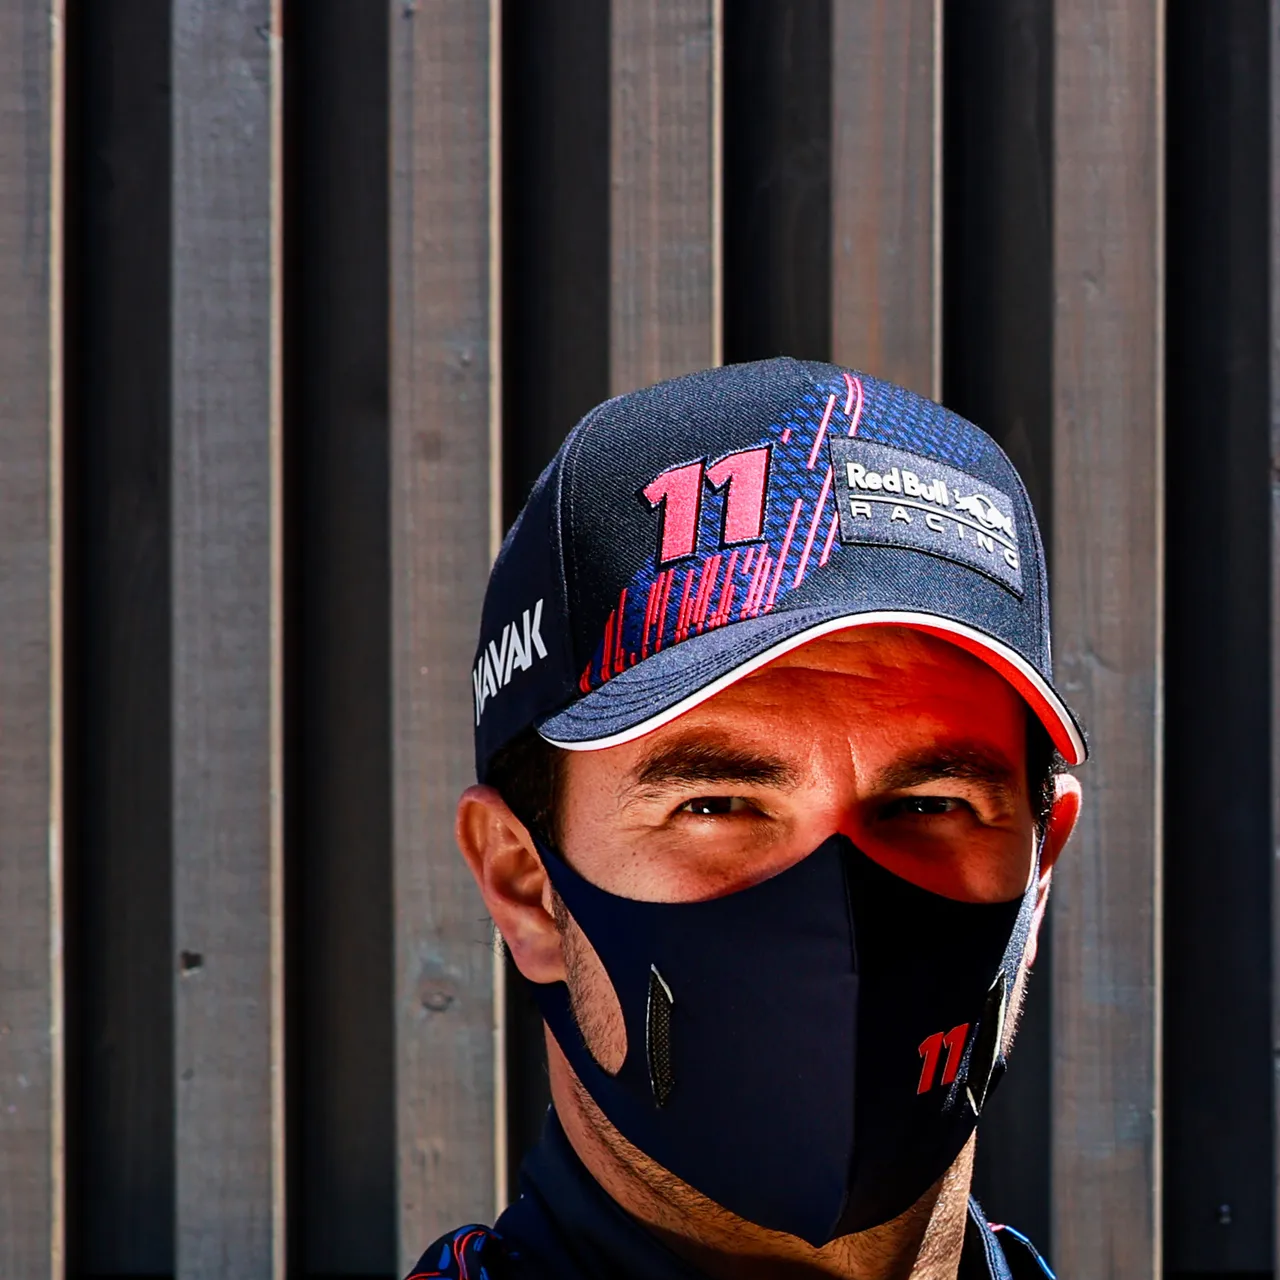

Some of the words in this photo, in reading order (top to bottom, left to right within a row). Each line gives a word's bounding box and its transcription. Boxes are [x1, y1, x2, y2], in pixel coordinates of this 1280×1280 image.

[642, 441, 773, 564] 11
[846, 462, 901, 494] Red
[902, 470, 951, 506] Bull
[851, 501, 1020, 570] RACING
[917, 1022, 970, 1095] 11
